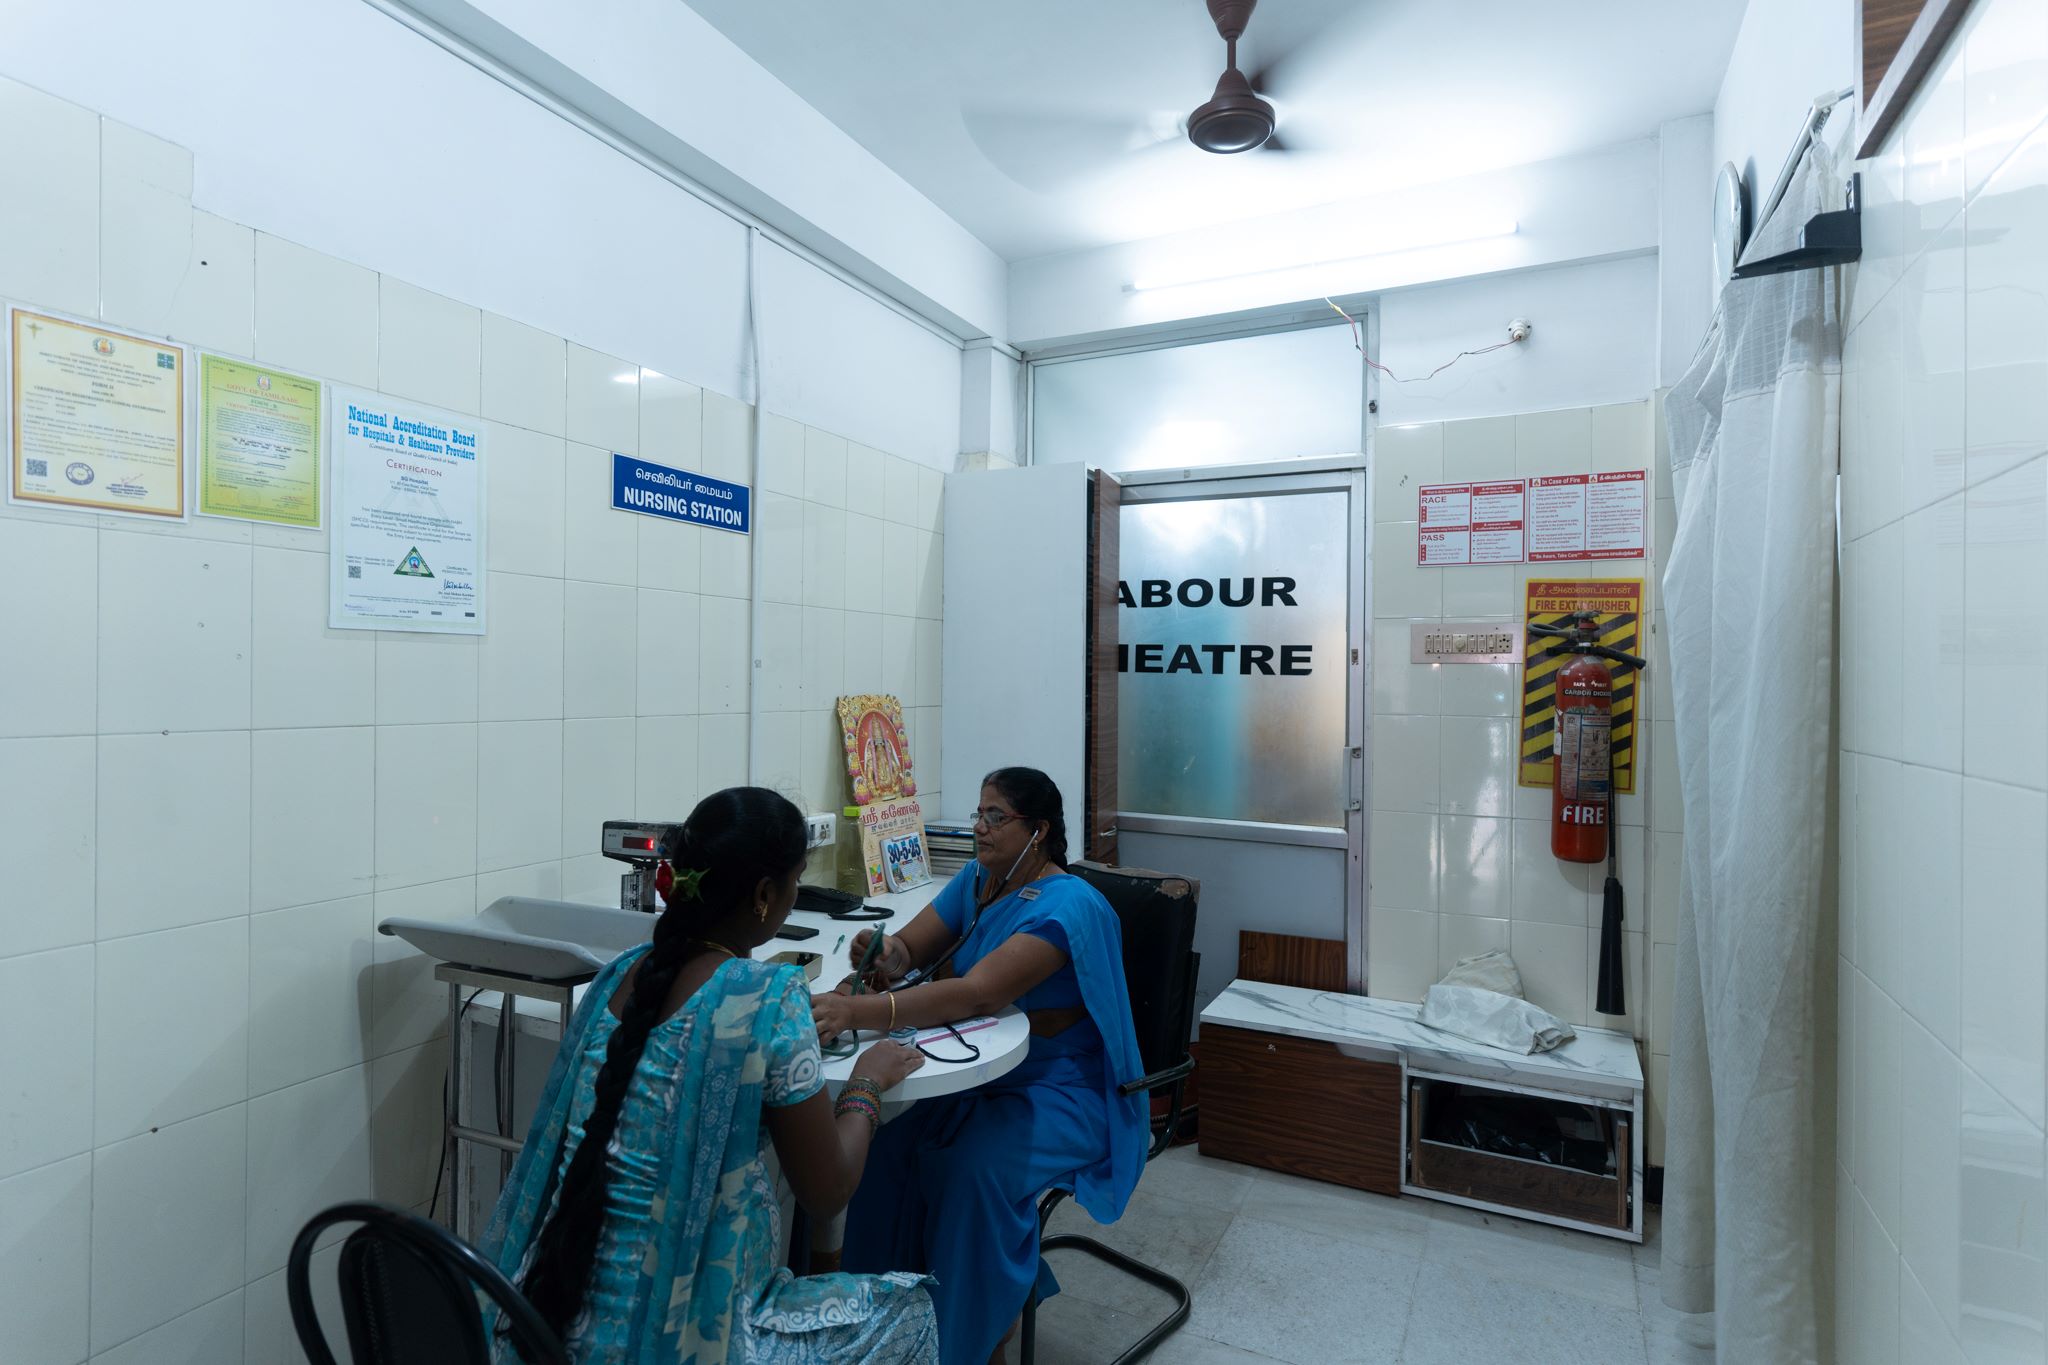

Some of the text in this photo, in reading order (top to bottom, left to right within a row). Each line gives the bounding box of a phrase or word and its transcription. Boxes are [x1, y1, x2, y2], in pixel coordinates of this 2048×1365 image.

[348, 405, 475, 448] National Accreditation Board
[348, 423, 475, 460] for Hospitals & Healthcare Providers
[386, 458, 442, 477] CERTIFICATION
[635, 468, 733, 500] செவிலியர் மையம்
[624, 486, 742, 526] NURSING STATION
[1118, 576, 1298, 608] ABOUR
[1536, 584, 1546, 596] தீ
[1536, 600, 1556, 611] FIRE
[1118, 644, 1313, 676] EATRE
[1563, 805, 1604, 824] FIRE
